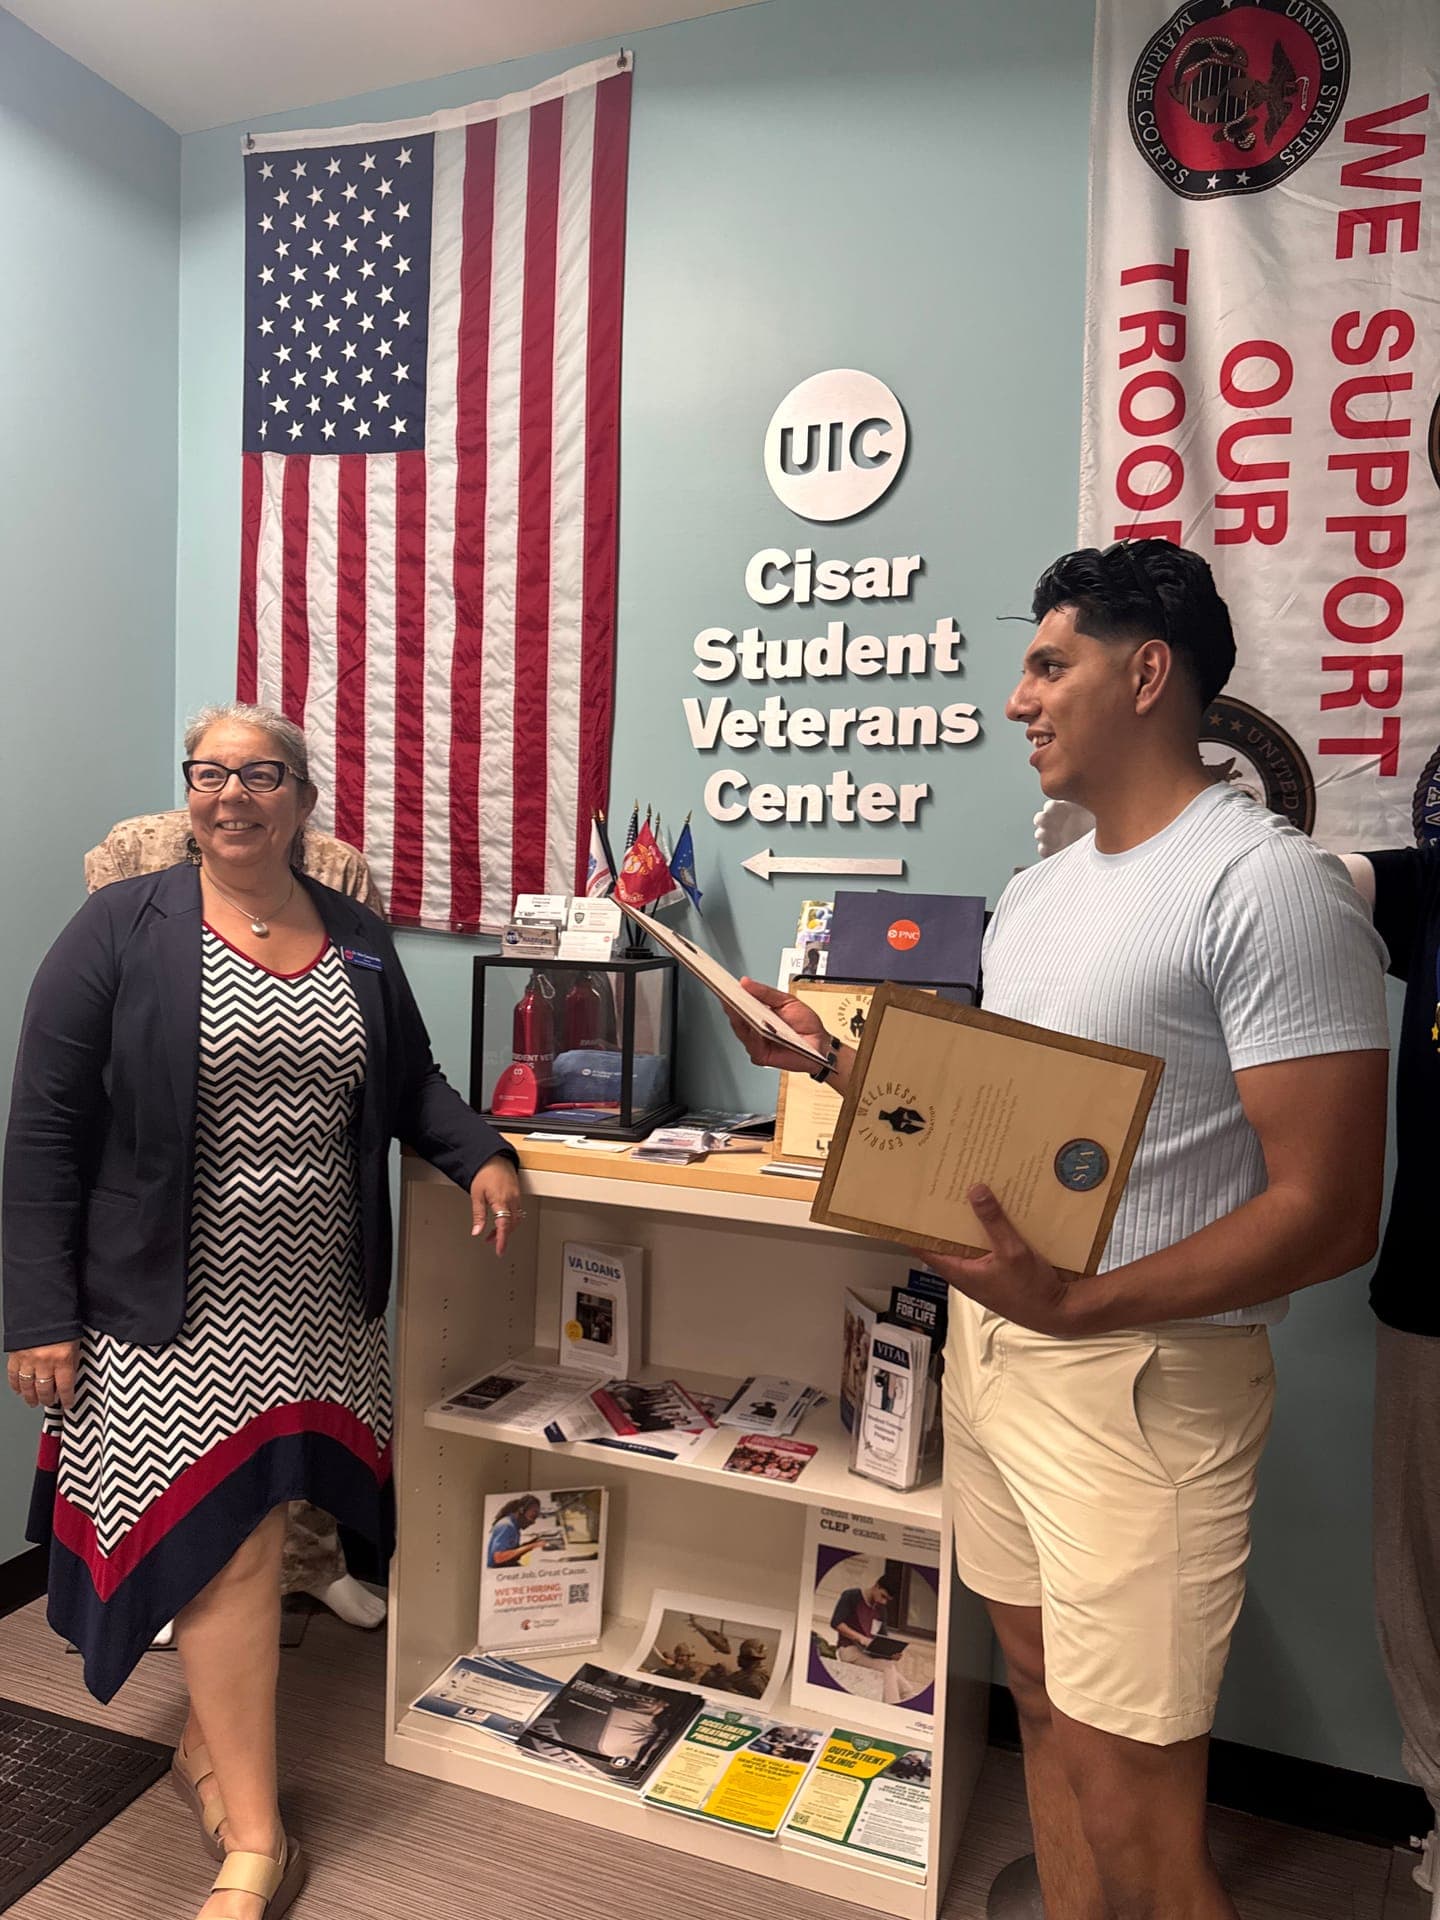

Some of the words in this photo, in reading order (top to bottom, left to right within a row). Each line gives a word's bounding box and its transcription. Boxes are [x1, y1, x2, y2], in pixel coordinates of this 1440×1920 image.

[1136, 13, 1197, 102] MARINE
[1285, 0, 1340, 71] UNITED
[1137, 111, 1189, 185] CORPS
[1280, 84, 1338, 166] STATES
[1336, 93, 1430, 260] WE
[1114, 248, 1190, 546] TROO
[779, 417, 892, 475] UIC
[1214, 340, 1294, 545] OUR
[1318, 309, 1416, 776] SUPPORT
[744, 547, 921, 605] Cisar
[692, 617, 961, 681] Student
[682, 695, 980, 749] Veterans
[703, 769, 928, 823] Center
[1247, 727, 1299, 809] UNITED
[899, 930, 920, 940] PNC
[857, 1082, 917, 1117] WELLNESS
[858, 1127, 904, 1151] ESPRIT
[568, 1255, 583, 1269] VA
[585, 1260, 621, 1279] LOANS
[896, 1302, 914, 1318] FOR
[915, 1308, 936, 1326] LIFE
[877, 1342, 907, 1364] VITAL
[820, 1518, 850, 1533] CLEP
[824, 1754, 858, 1769] CLINIC
[828, 1745, 887, 1766] OUTPATIENT
